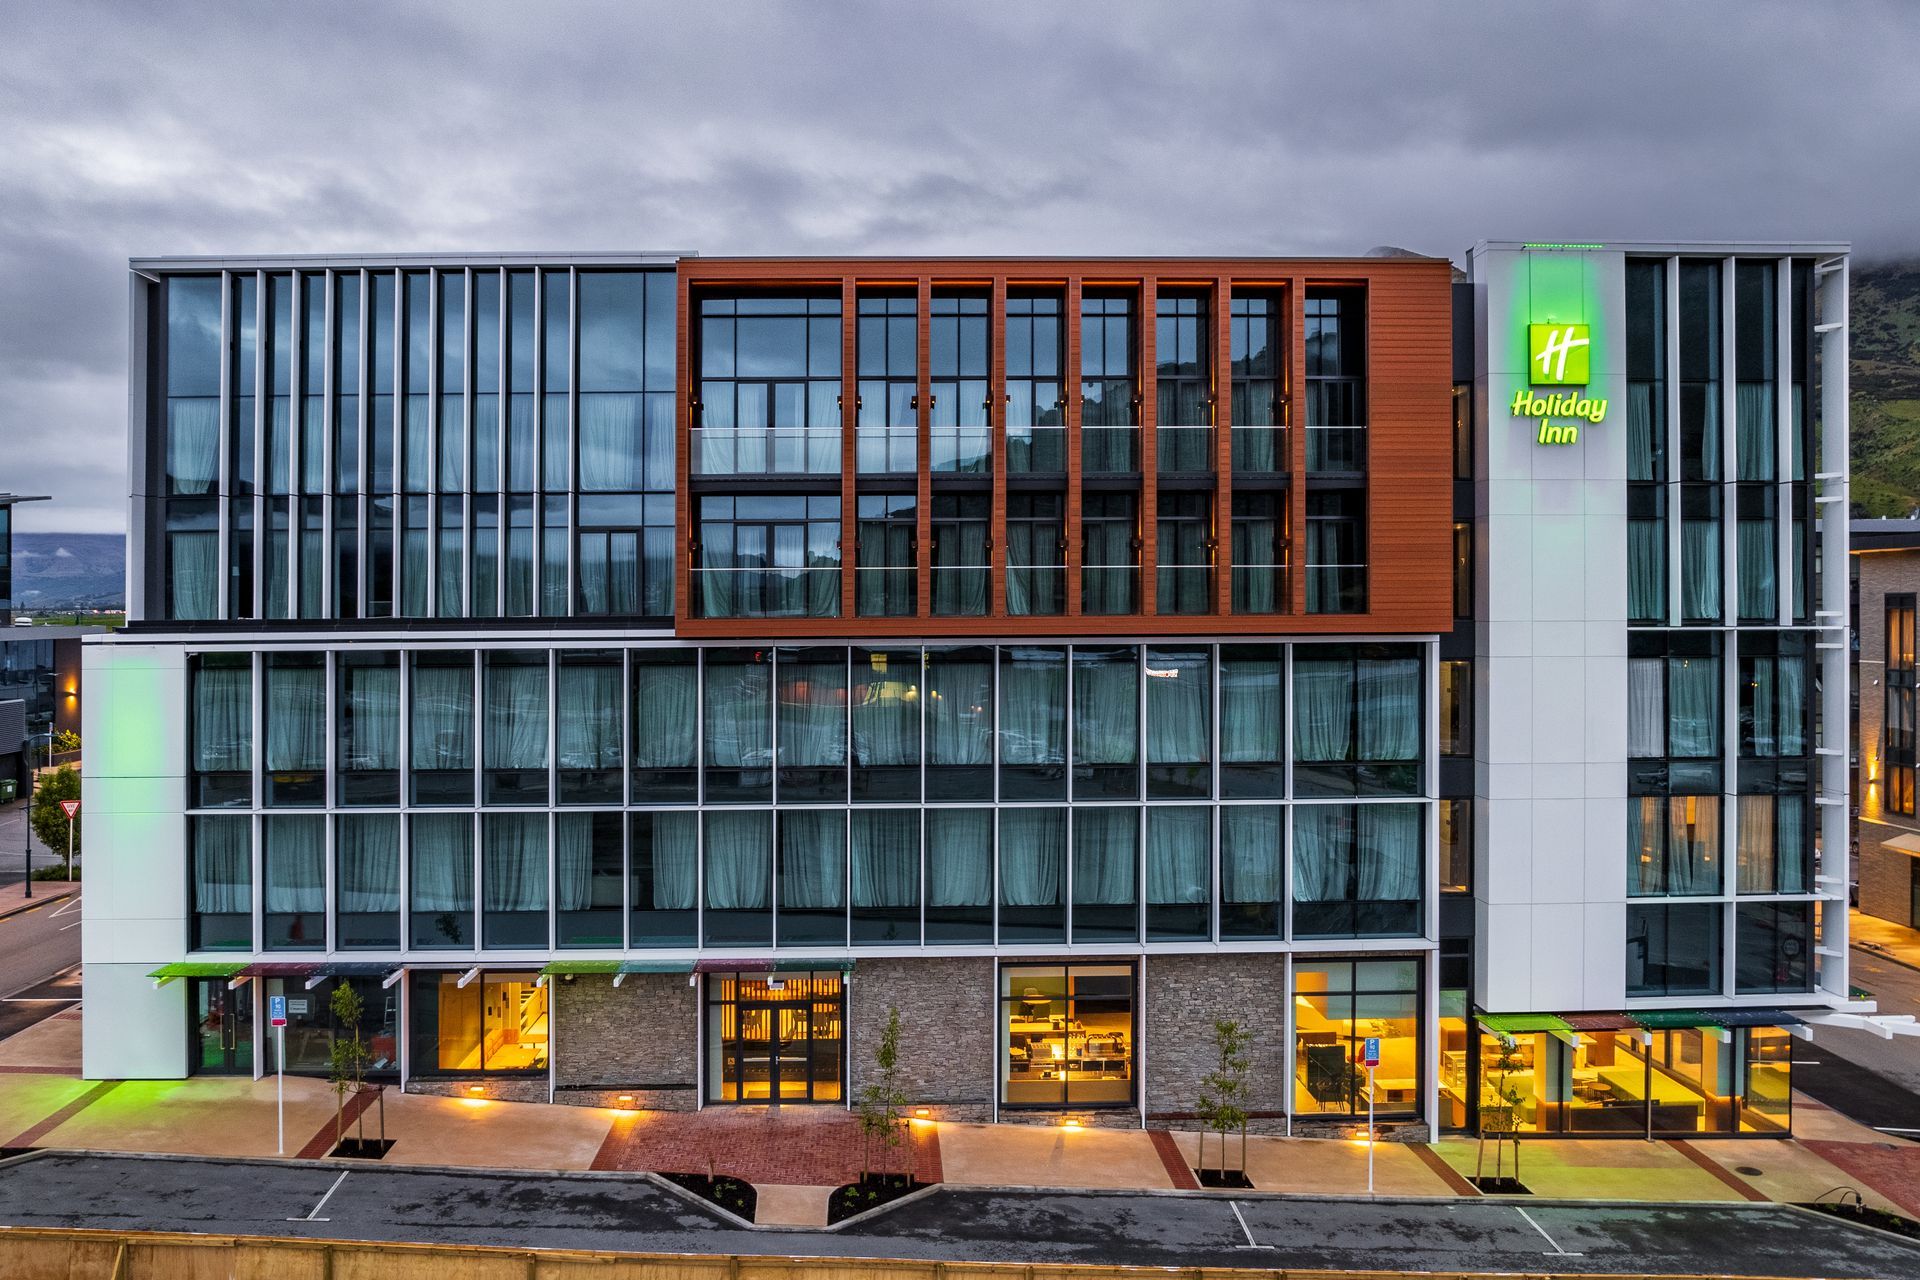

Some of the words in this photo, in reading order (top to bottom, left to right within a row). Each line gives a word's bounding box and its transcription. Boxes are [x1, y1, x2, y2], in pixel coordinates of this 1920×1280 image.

[1535, 327, 1589, 381] H
[1512, 390, 1608, 424] Holiday
[1538, 418, 1578, 445] Inn
